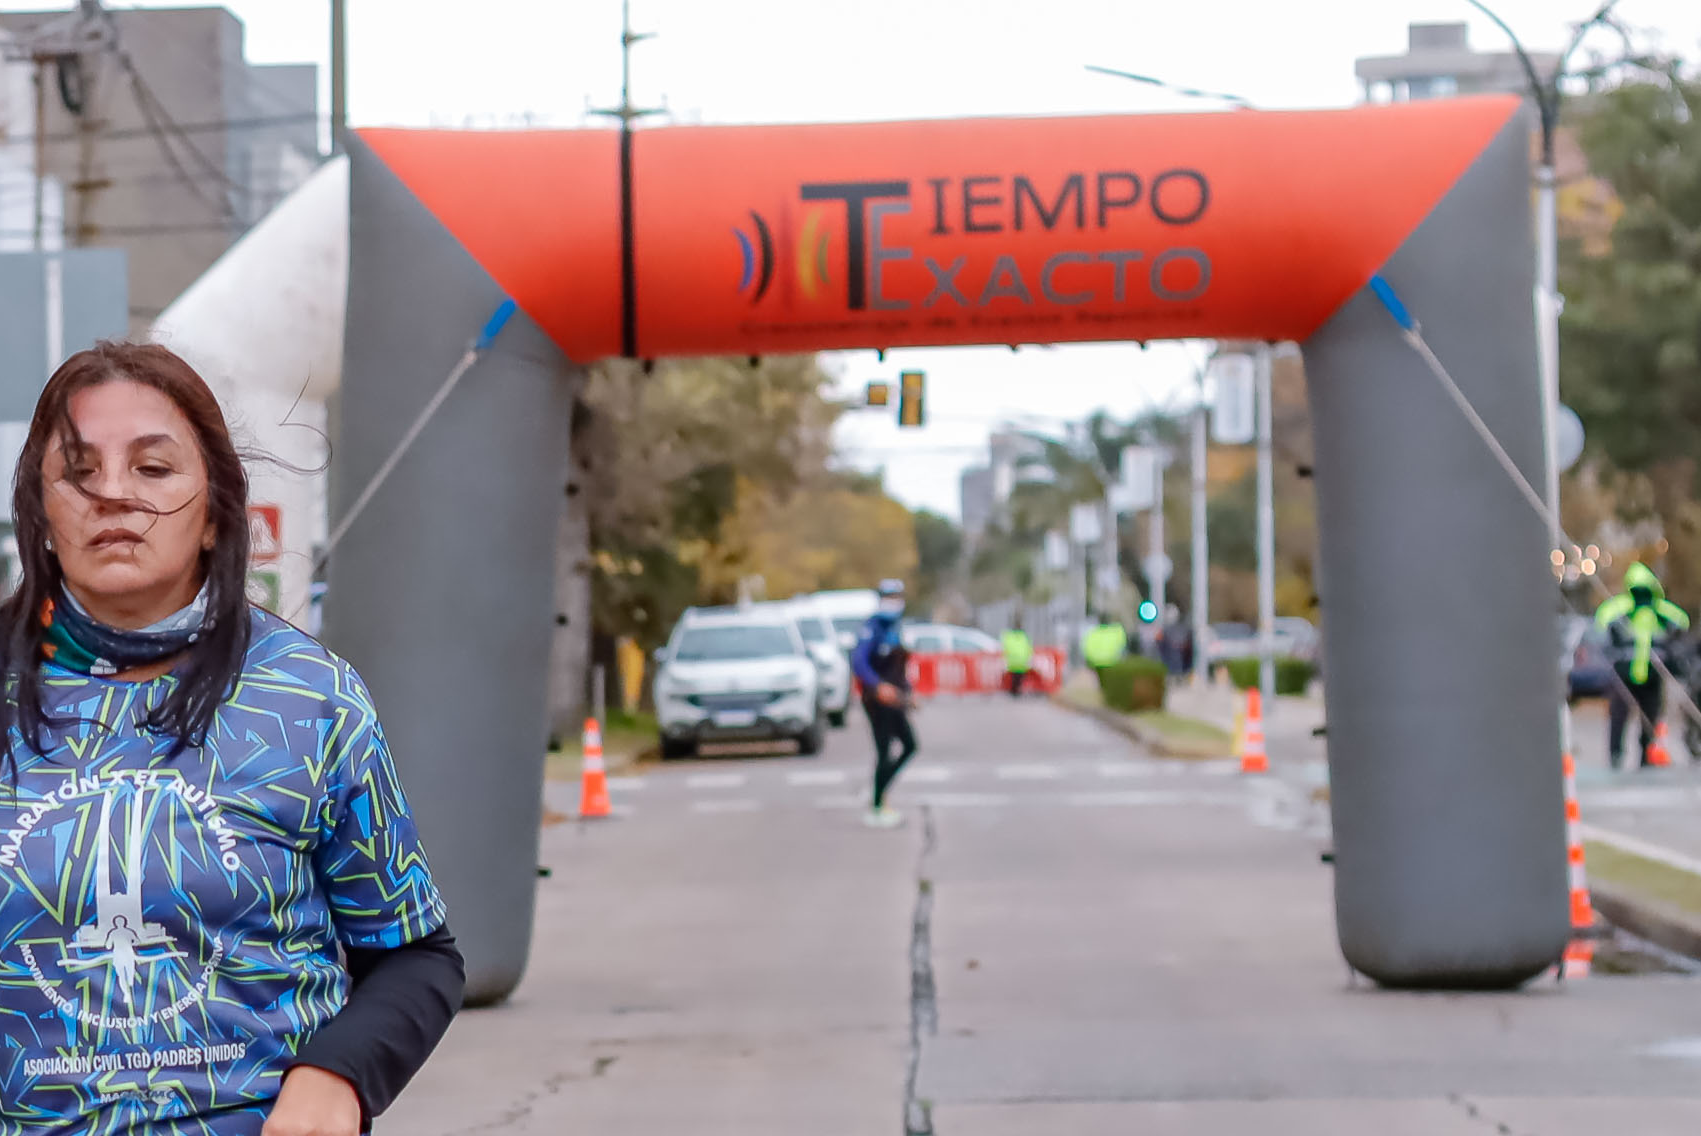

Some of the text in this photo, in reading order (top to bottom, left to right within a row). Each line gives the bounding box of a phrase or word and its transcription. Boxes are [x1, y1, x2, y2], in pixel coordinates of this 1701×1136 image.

[799, 168, 1212, 312] TIEMPO
[870, 201, 1213, 312] EXACTO
[109, 769, 127, 786] X
[134, 769, 160, 787] EL
[165, 779, 241, 871] AUTISMO
[201, 935, 224, 983] POSITIVA
[23, 1042, 246, 1076] ASOCIACIÓN CIVIL TGD PADRES UNIDOS
